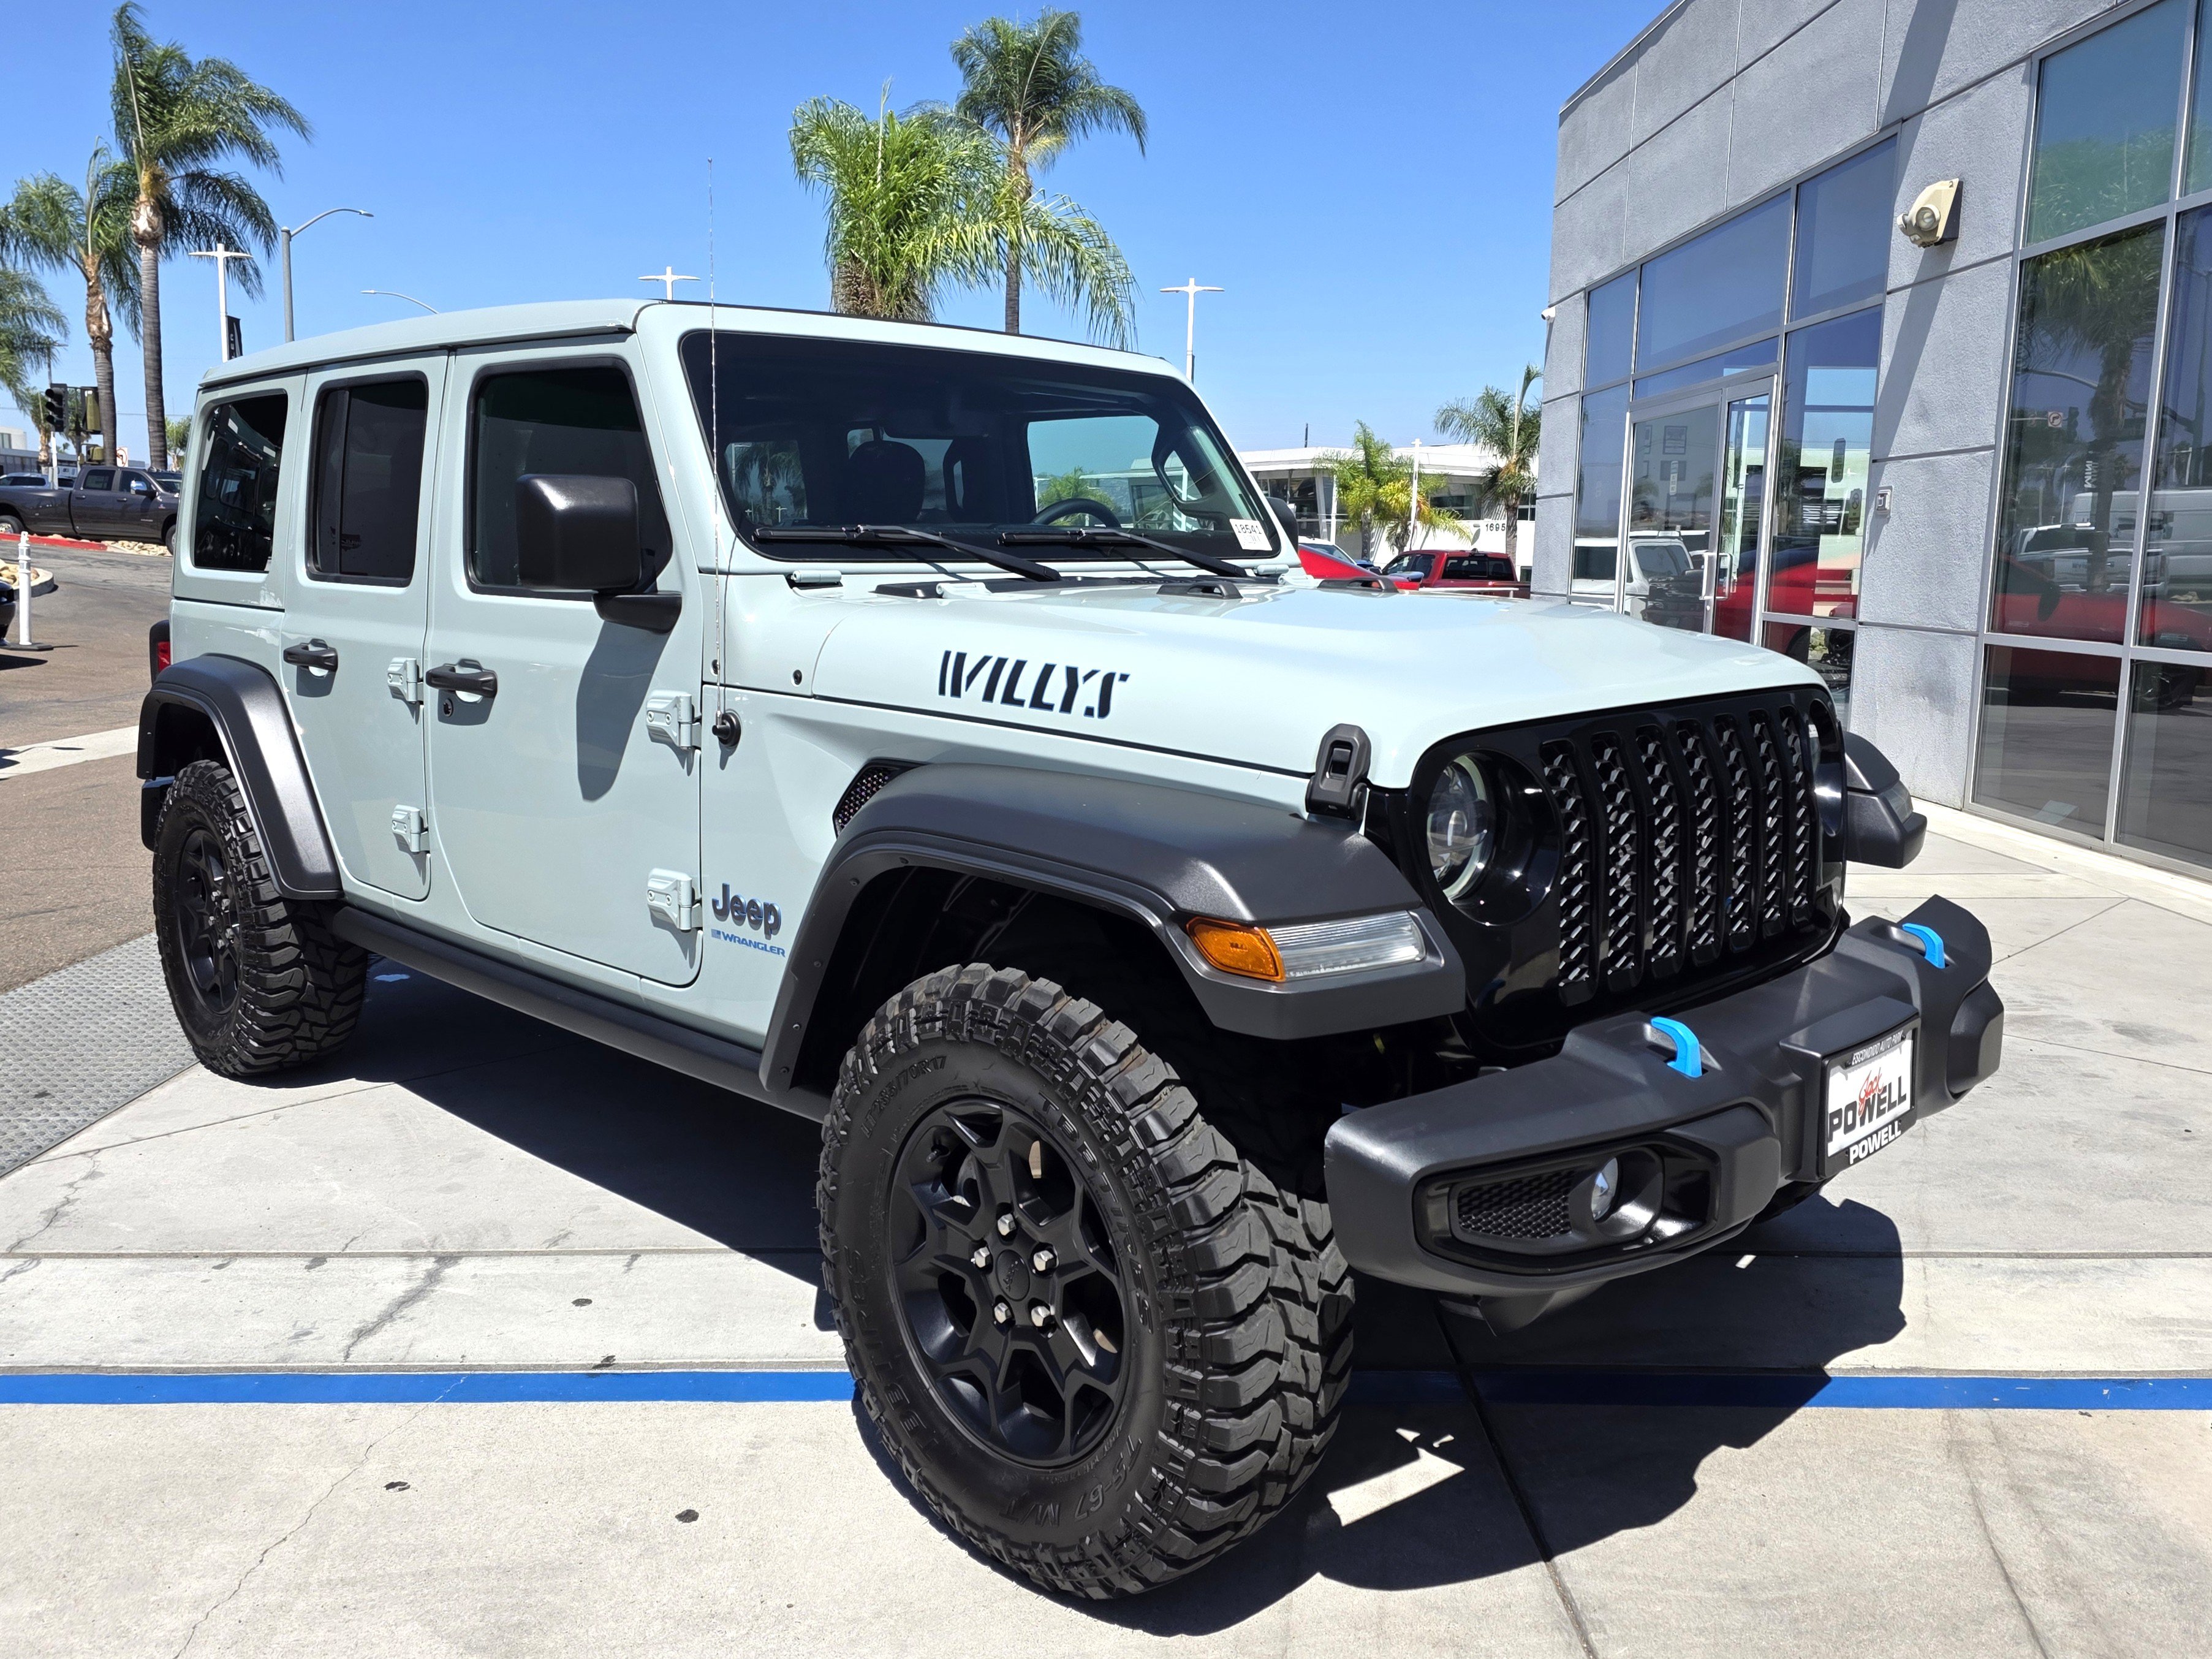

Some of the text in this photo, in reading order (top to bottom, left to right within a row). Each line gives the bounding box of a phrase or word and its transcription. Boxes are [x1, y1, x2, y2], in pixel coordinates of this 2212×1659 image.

[938, 650, 1131, 719] WILLYS
[712, 883, 781, 940] Jeep
[722, 931, 786, 957] WRANGLER
[1852, 1042, 1880, 1065] ESCONDIDO
[1879, 1036, 1892, 1053] AUTO
[1827, 1076, 1907, 1143] POWELL
[1858, 1067, 1884, 1117] Jack
[1849, 1120, 1901, 1164] POWELL
